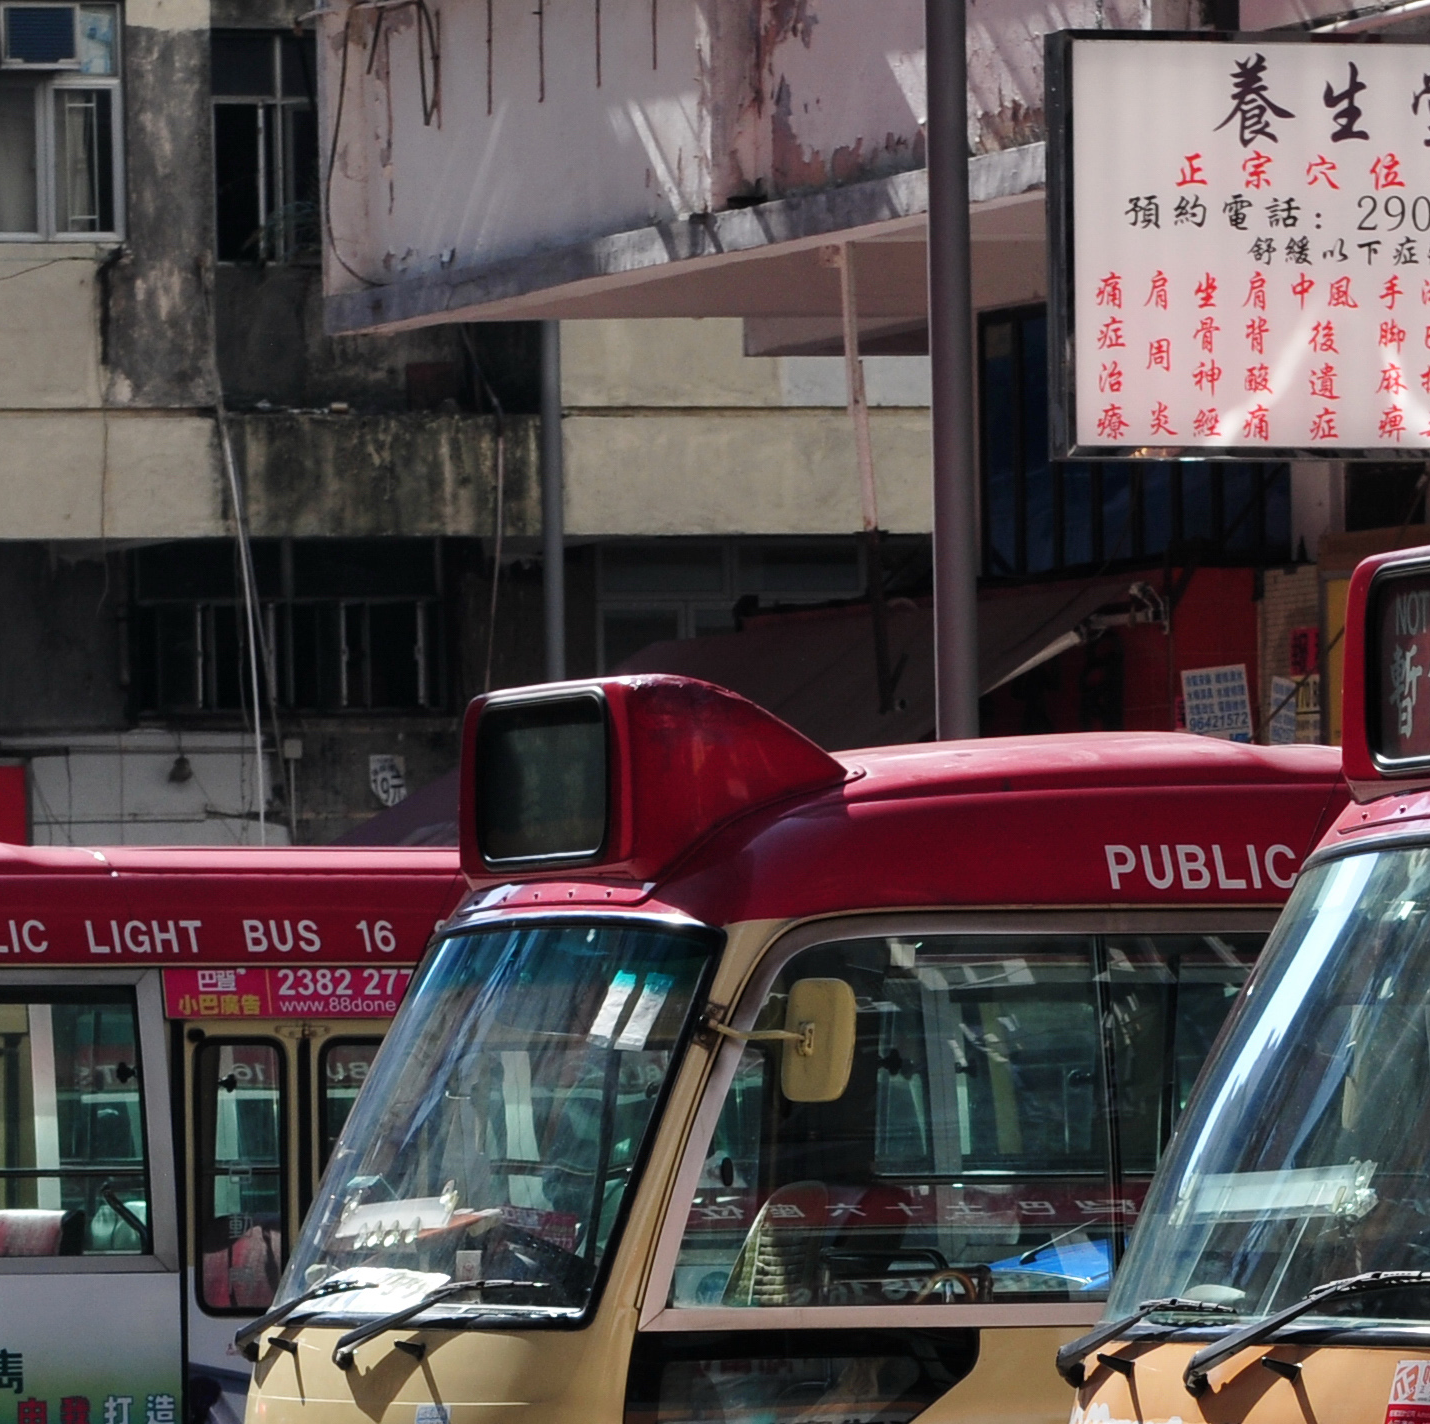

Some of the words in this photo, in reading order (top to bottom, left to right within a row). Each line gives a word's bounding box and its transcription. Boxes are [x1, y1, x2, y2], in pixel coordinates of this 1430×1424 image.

[1097, 271, 1129, 440] 痛症治療
[1143, 270, 1177, 437] 肩周炎
[1192, 271, 1224, 440] 坐骨神經
[1242, 272, 1273, 441] 肩背酸痛
[1290, 273, 1359, 441] 中風後遺症
[1395, 589, 1430, 635] NOT
[1104, 844, 1298, 890] PUBLIC
[84, 920, 202, 954] LIGHT
[242, 919, 321, 954] BUS
[355, 920, 397, 954] 16
[277, 968, 353, 996] 2382
[178, 993, 261, 1016] 小巴廣告
